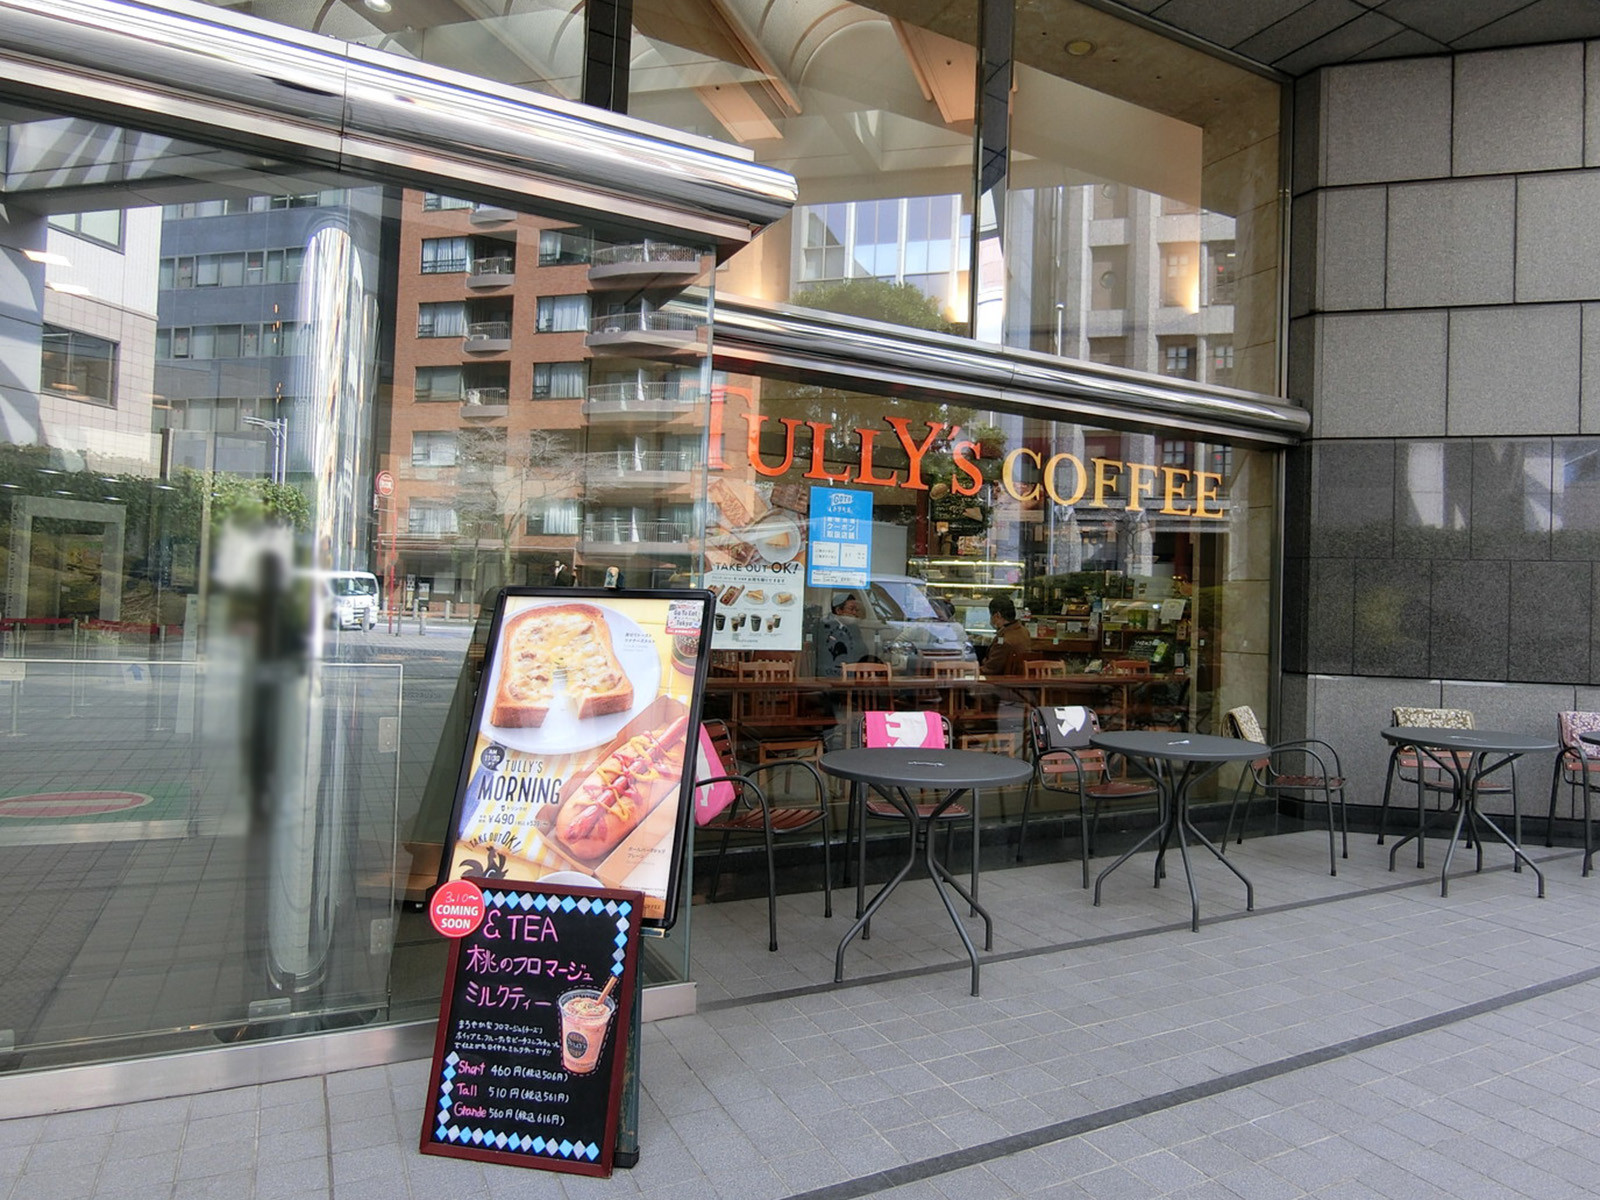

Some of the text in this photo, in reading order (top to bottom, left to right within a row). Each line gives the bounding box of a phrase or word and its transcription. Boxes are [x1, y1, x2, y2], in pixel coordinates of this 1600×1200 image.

[1002, 447, 1223, 519] COFFEE
[715, 561, 799, 575] TAKE OUT OK!
[505, 759, 543, 774] TULLY'S
[477, 775, 562, 805] MORNING
[469, 833, 487, 849] TAKE
[436, 904, 479, 916] COMING
[441, 918, 470, 929] SOON
[507, 914, 558, 942] TEA
[465, 944, 593, 981] 桃のフロマージュ
[465, 981, 552, 1010] ミルクティー
[456, 1082, 477, 1096] Tall
[453, 1101, 487, 1118] Grande
